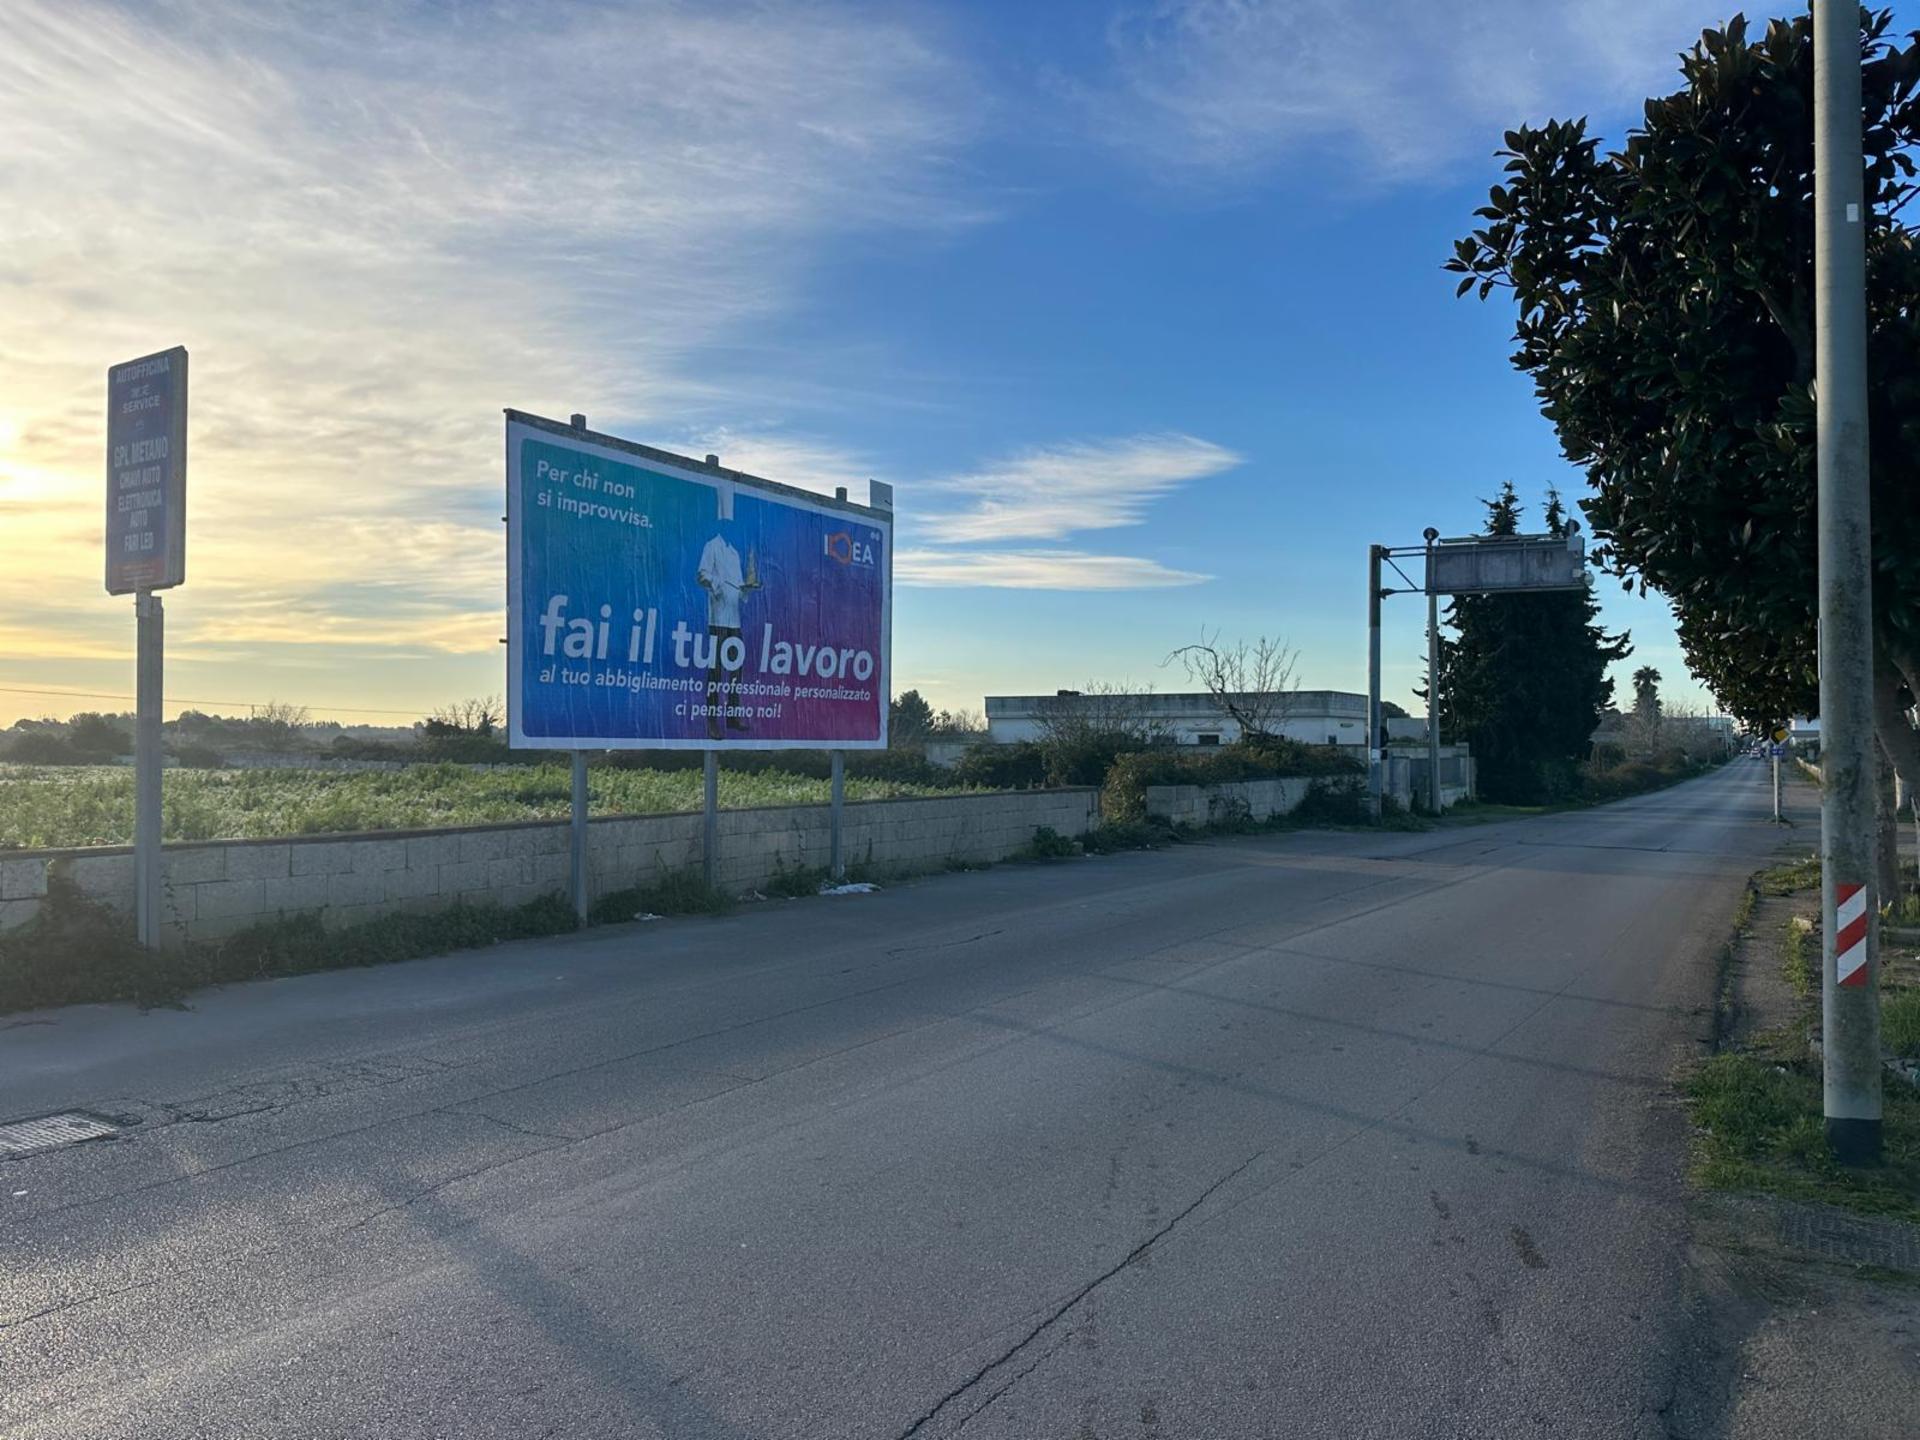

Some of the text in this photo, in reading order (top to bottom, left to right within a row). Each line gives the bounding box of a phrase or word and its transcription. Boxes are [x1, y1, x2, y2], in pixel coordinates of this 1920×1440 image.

[116, 356, 170, 384] AUTOFFICINA
[122, 394, 160, 414] SERVICE
[114, 436, 169, 468] GPL METANO
[536, 460, 635, 499] Per chi non
[537, 489, 653, 529] si improvvisa.
[539, 594, 873, 681] fai il tuo lavoro
[539, 664, 871, 702] al tuo abbigliamento professionale personalizzato
[675, 700, 781, 720] ci pensiamo noi!
